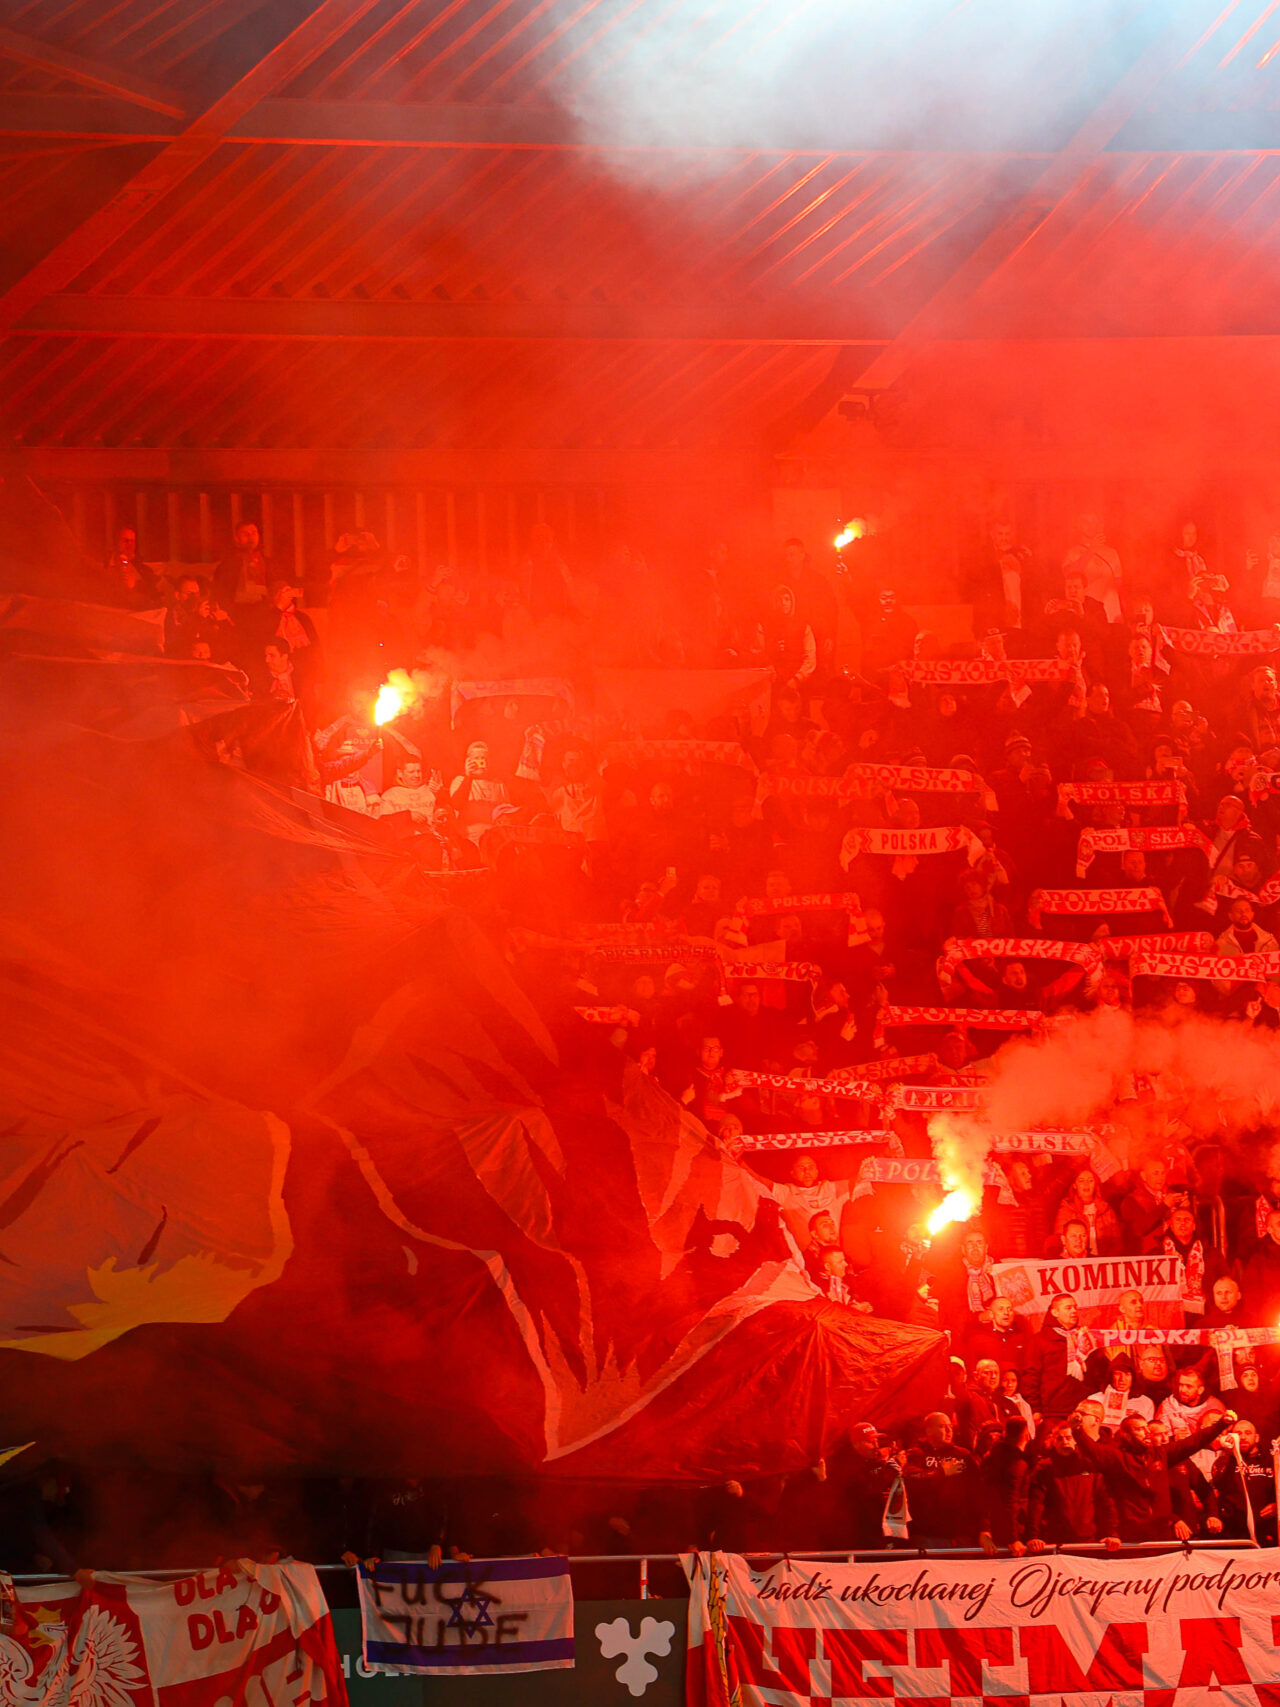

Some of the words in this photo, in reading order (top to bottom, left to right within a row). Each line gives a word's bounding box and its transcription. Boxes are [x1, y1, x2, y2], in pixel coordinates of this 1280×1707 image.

[1169, 628, 1263, 654] POLSKA
[775, 776, 865, 798] POLSKA
[862, 766, 966, 791] POLSKA
[1082, 785, 1173, 800] POLSKA
[880, 830, 937, 851] POLSKA
[1092, 833, 1127, 846] POL
[1151, 830, 1186, 845] SKA
[772, 894, 832, 908] POLSKA
[1050, 888, 1153, 912] POLSKA
[970, 938, 1064, 960] POLSKA
[1141, 952, 1254, 979] POLSKA
[903, 1006, 1028, 1024] POLSKA
[765, 1132, 873, 1150] POLSKA
[1039, 1256, 1180, 1297] KOMINKI
[1100, 1329, 1201, 1345] POLSKA
[173, 1566, 239, 1607] DLA
[370, 1564, 502, 1608] FUCK
[840, 1569, 997, 1621] ukochanej
[1008, 1562, 1163, 1618] Ojczyzny
[186, 1604, 259, 1651] DLA
[381, 1612, 529, 1654] JUDE
